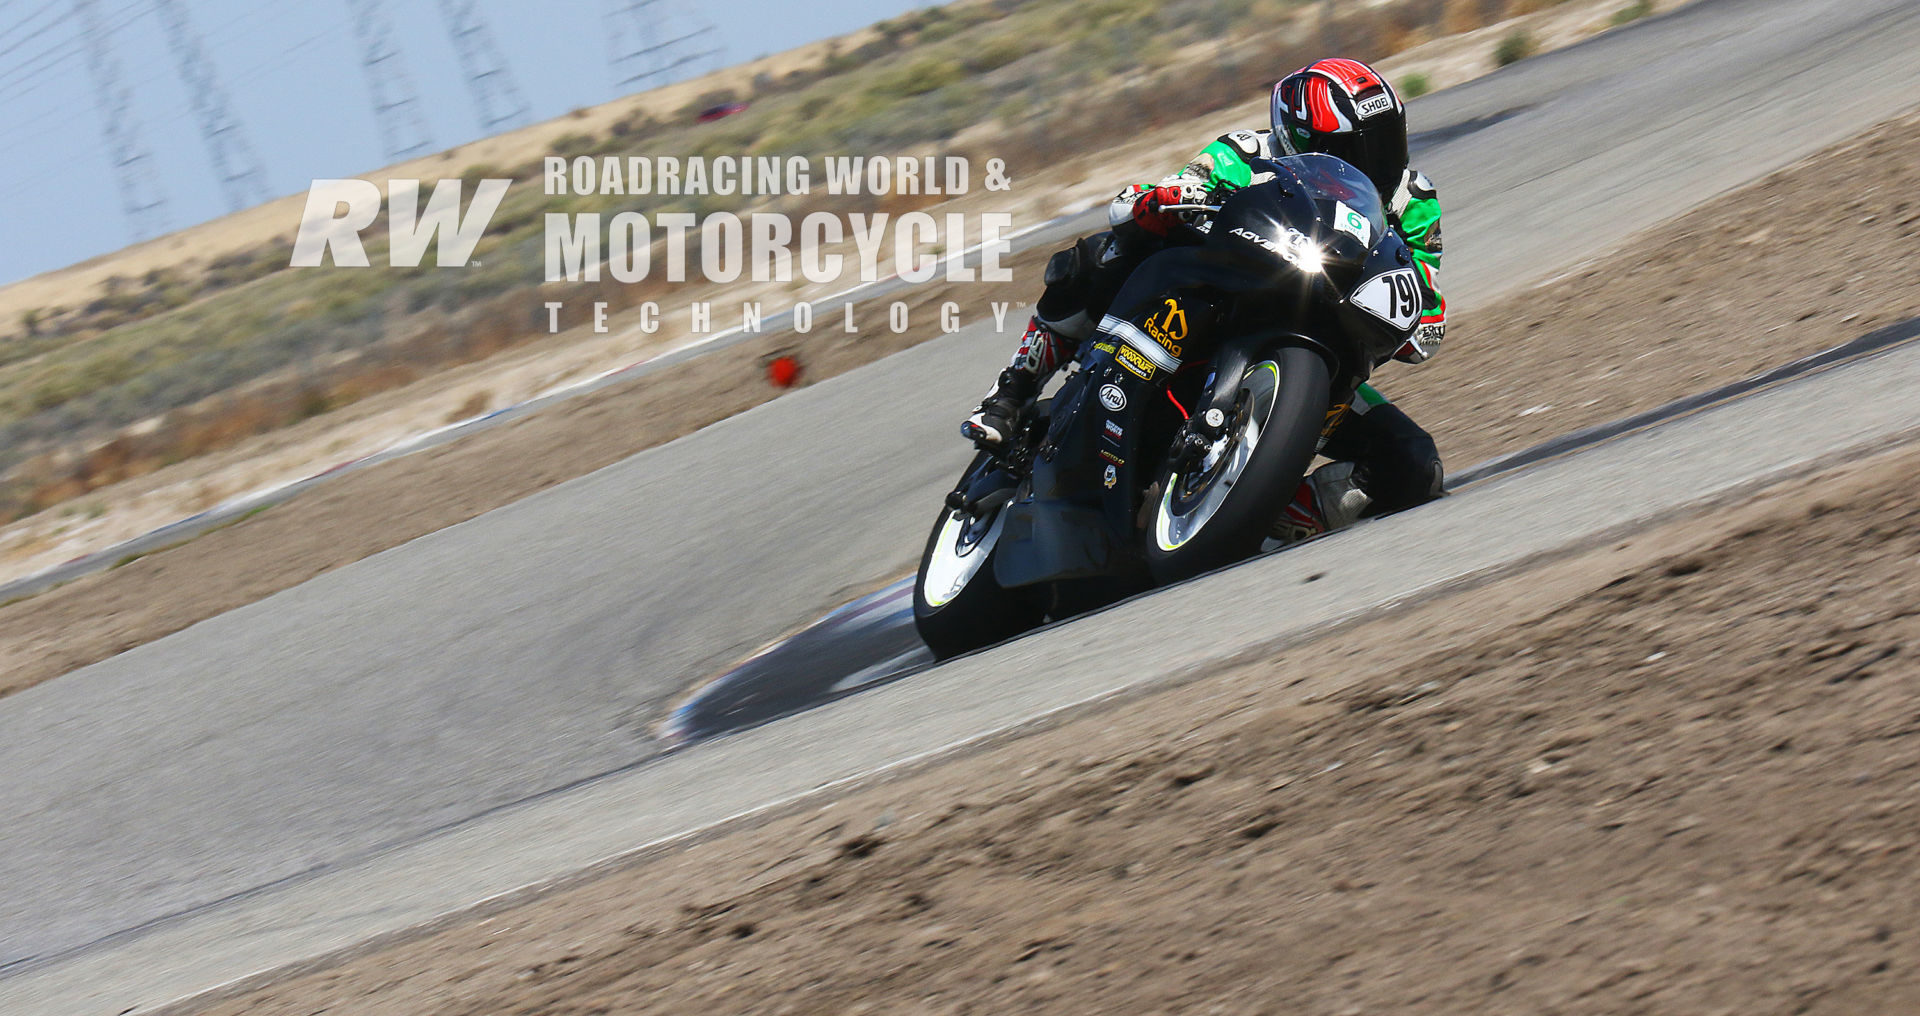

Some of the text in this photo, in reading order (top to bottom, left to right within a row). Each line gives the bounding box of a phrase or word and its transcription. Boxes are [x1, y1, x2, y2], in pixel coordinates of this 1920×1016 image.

[1347, 212, 1362, 230] 6
[1381, 273, 1419, 319] 791
[1143, 316, 1182, 358] Racing
[1101, 388, 1123, 406] Arai
